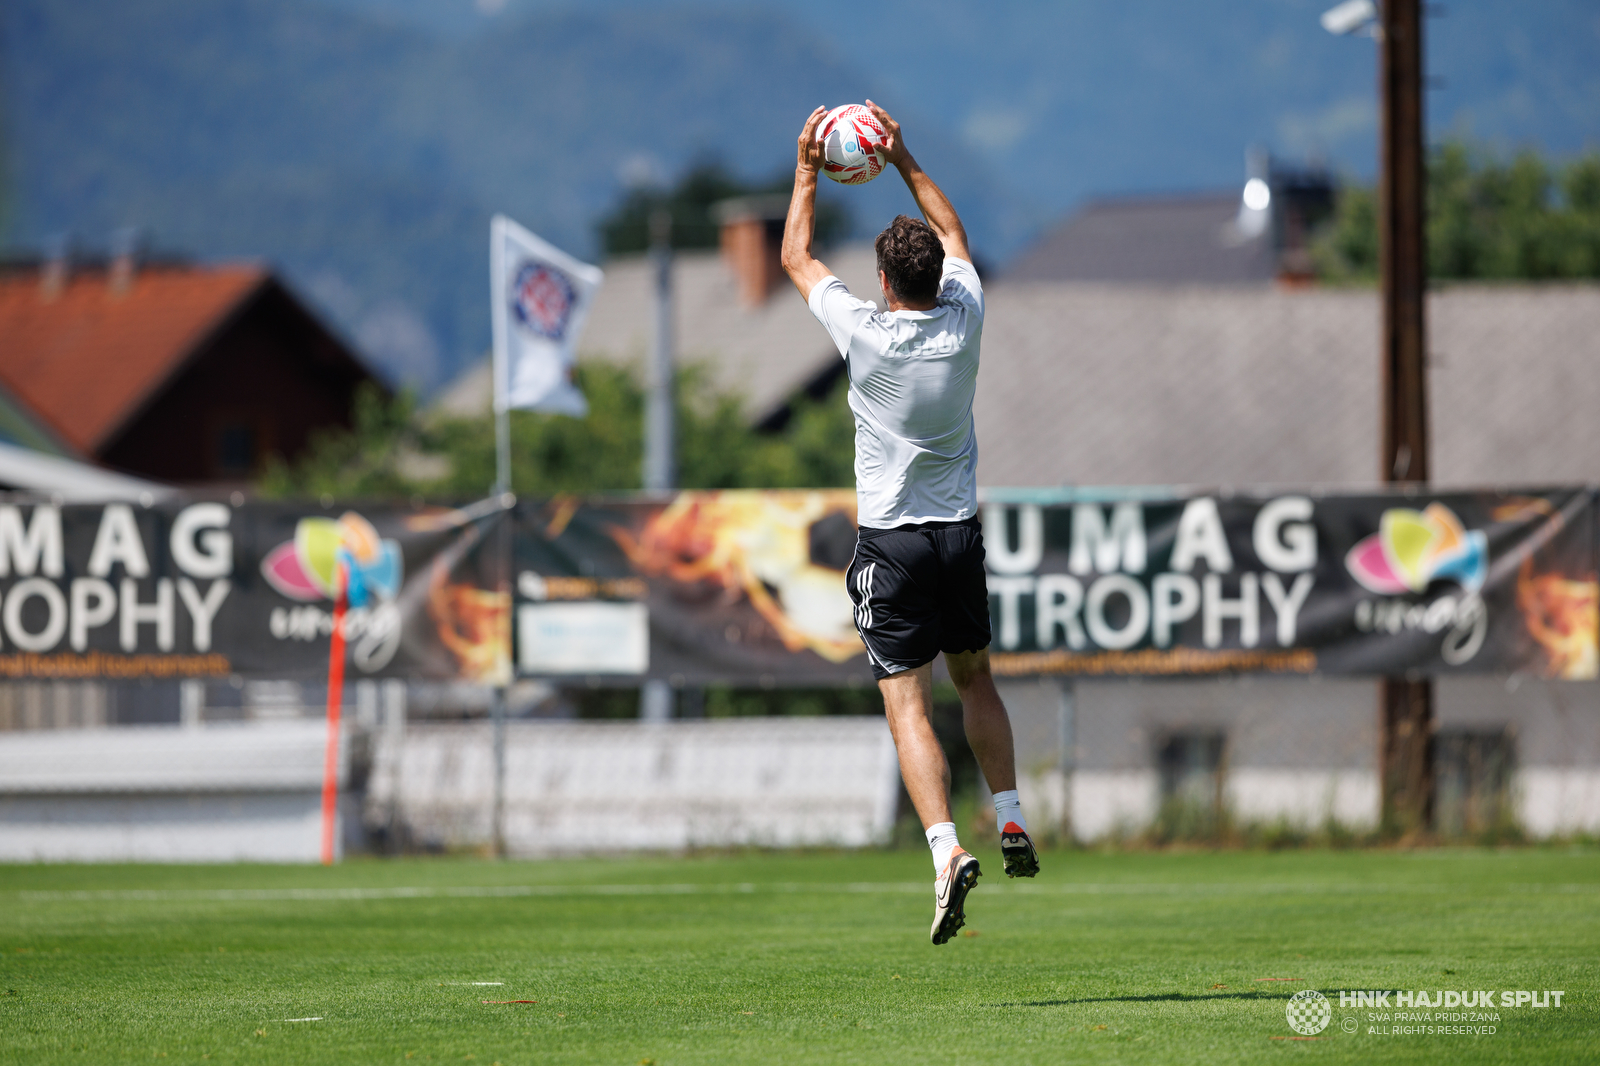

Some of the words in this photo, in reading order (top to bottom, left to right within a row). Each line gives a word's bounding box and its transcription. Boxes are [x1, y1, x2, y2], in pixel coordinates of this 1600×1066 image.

[983, 496, 1318, 574] UMAG
[0, 577, 231, 652] OPHY
[986, 573, 1315, 650] TROPHY
